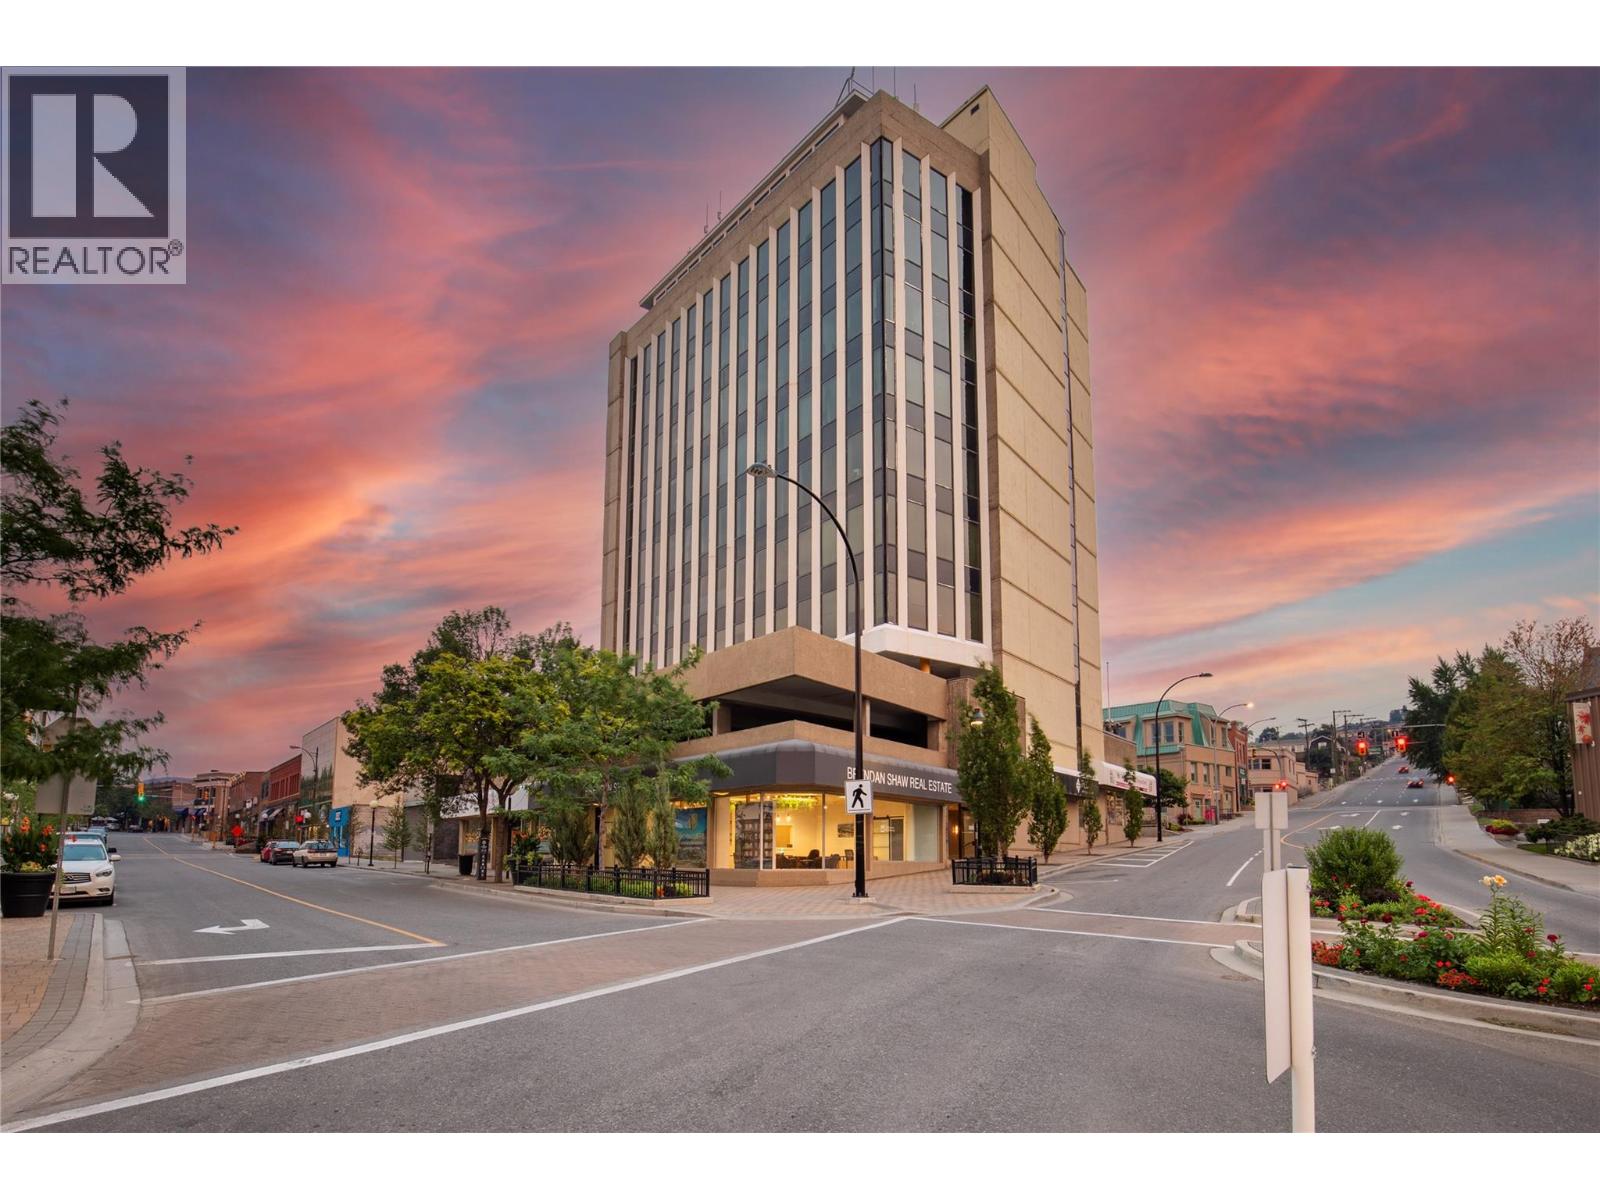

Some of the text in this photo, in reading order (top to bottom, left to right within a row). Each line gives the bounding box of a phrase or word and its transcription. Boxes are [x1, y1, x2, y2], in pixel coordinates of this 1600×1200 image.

[847, 766, 952, 794] BRNDAN SHAW REAL ESTATE
